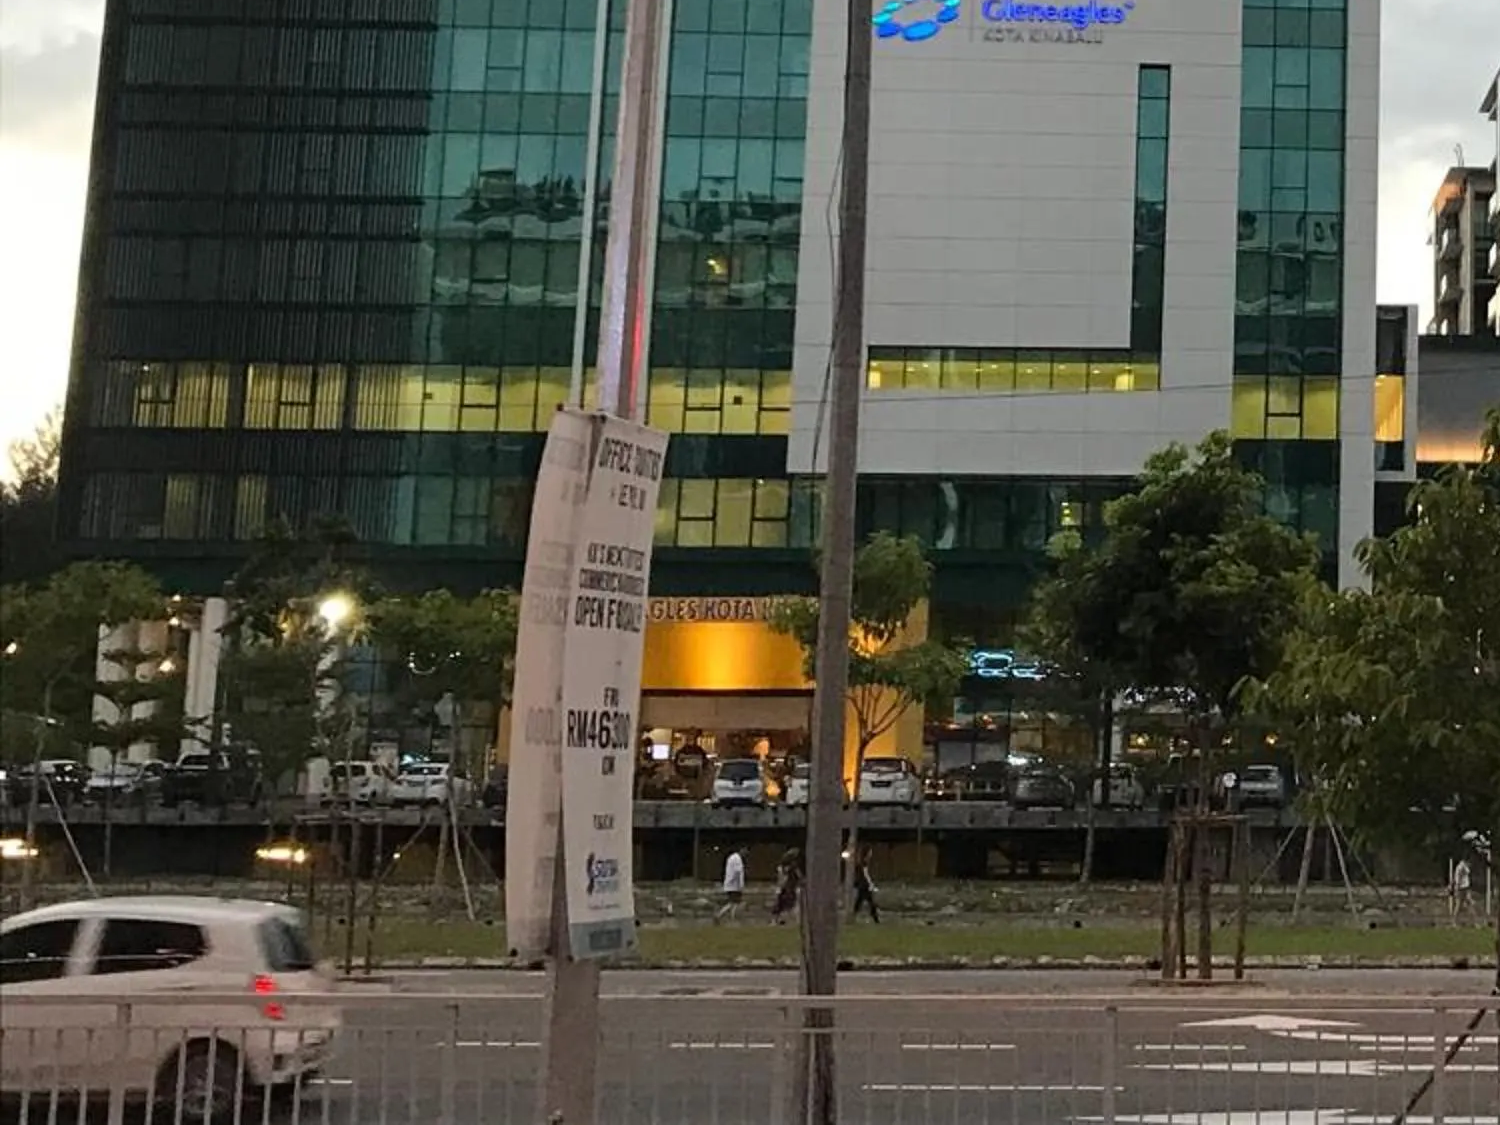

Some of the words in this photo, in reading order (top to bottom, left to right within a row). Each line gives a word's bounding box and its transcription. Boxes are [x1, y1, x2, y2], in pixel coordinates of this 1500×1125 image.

[983, 27, 1025, 43] KOTA
[574, 595, 605, 629] OPEN
[645, 599, 699, 620] GLES
[703, 599, 755, 620] KOTA
